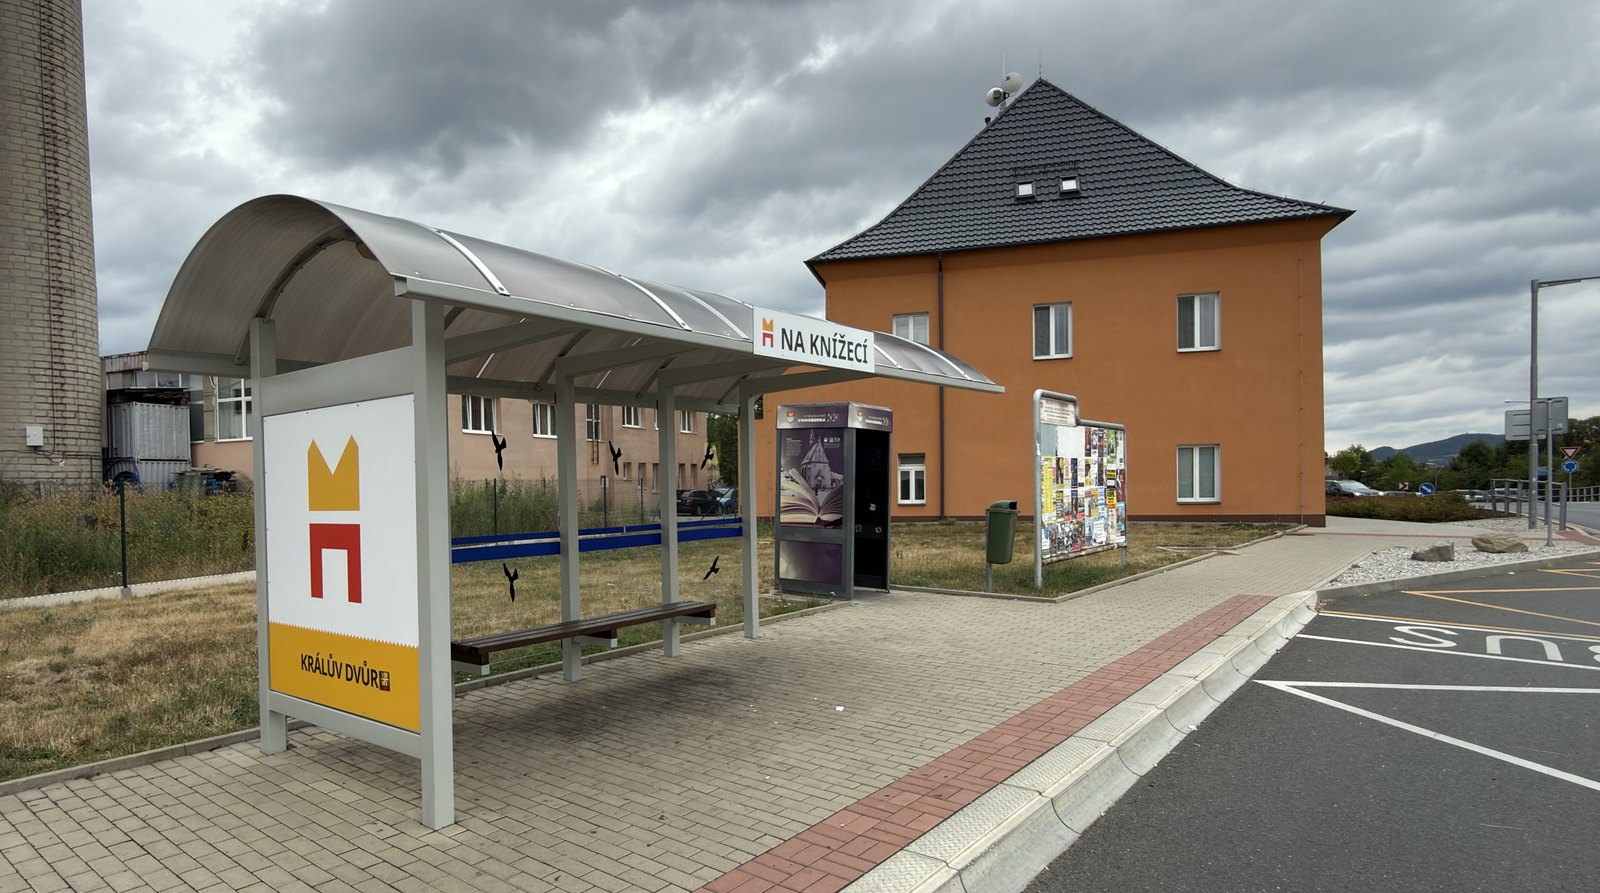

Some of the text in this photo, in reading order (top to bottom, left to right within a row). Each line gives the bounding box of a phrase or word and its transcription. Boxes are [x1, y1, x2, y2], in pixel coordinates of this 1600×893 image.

[781, 328, 868, 364] NA KNÍŽECÍ
[1389, 625, 1600, 664] US
[300, 652, 343, 679] KRÁLŮV
[345, 660, 379, 688] DVŮR
